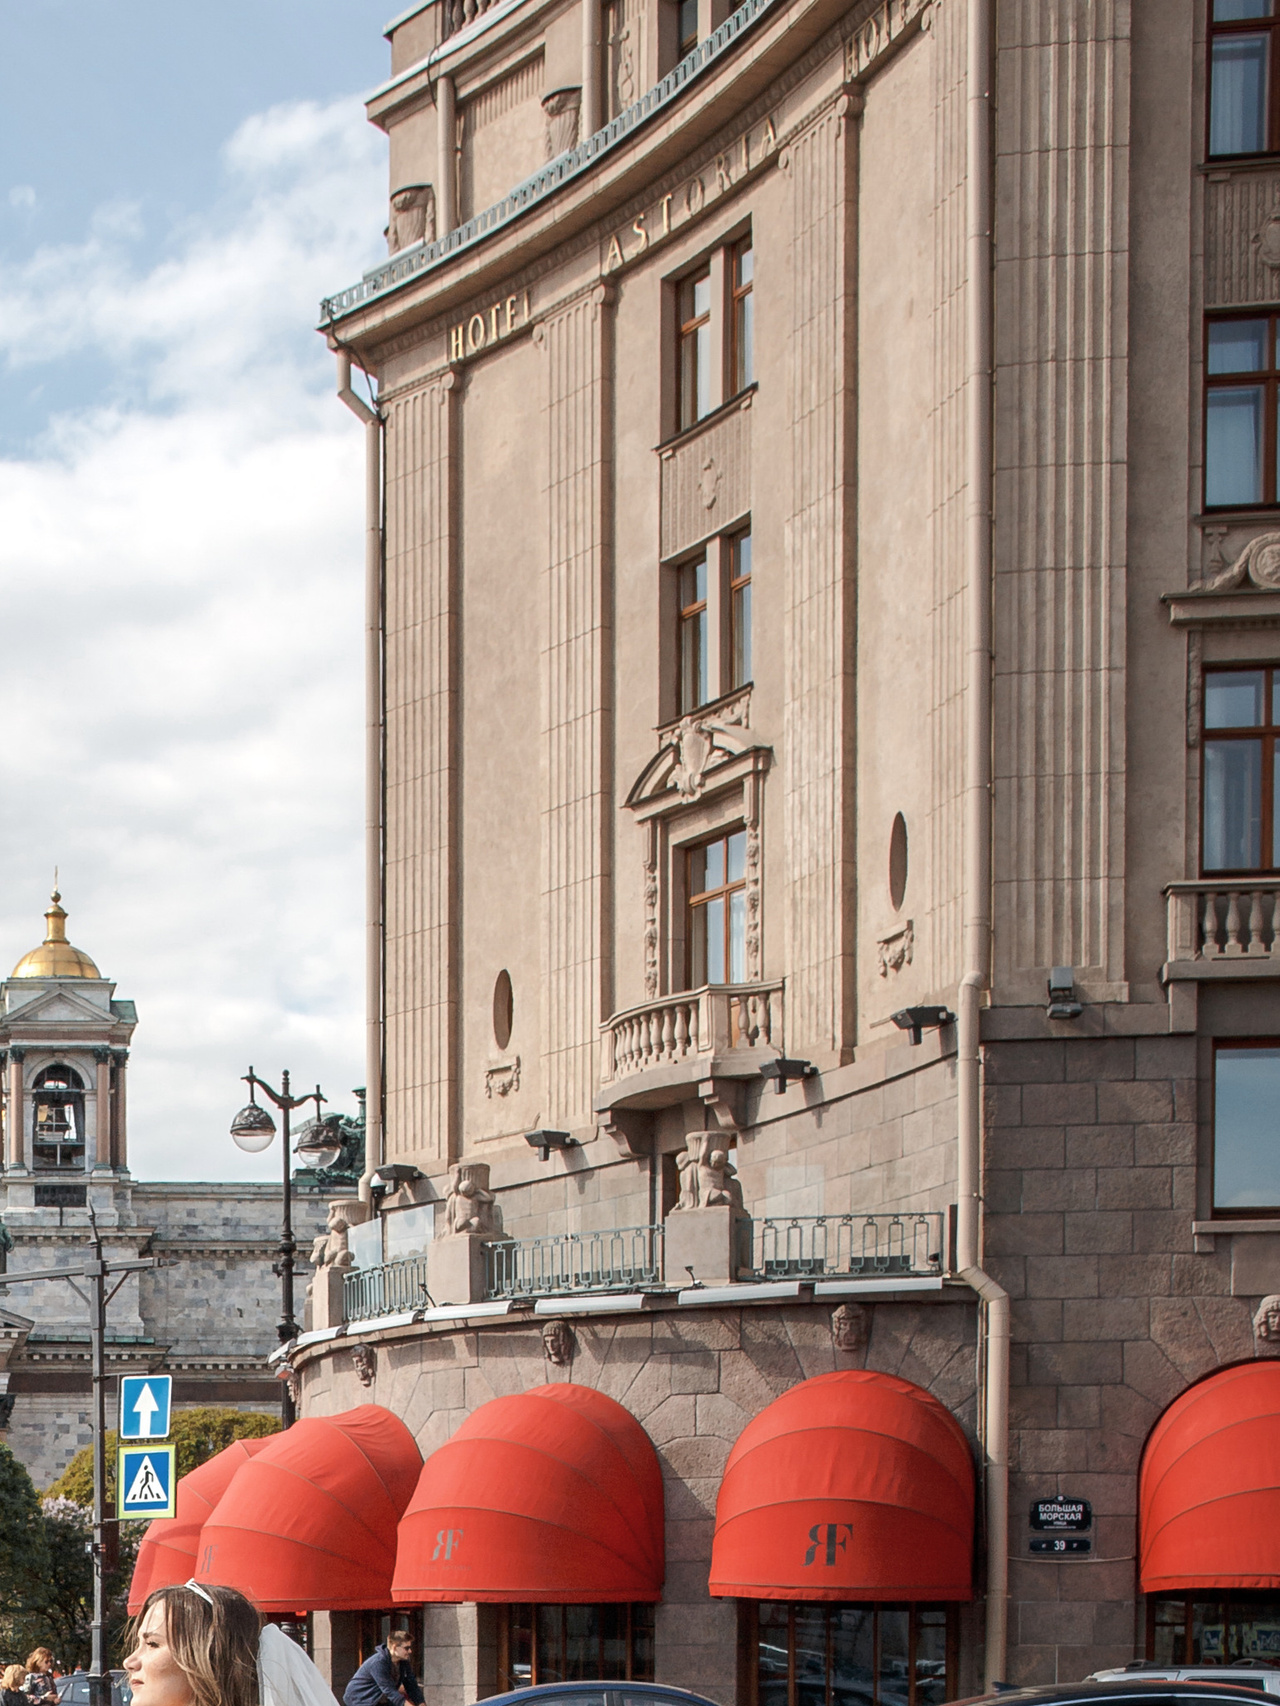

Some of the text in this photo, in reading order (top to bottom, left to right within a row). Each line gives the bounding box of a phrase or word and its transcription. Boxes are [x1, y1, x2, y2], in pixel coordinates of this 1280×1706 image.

[450, 116, 777, 362] HOTEL ASTORIA
[1038, 1504, 1083, 1512] БОЛЬШАЯ
[1054, 1540, 1066, 1551] 39
